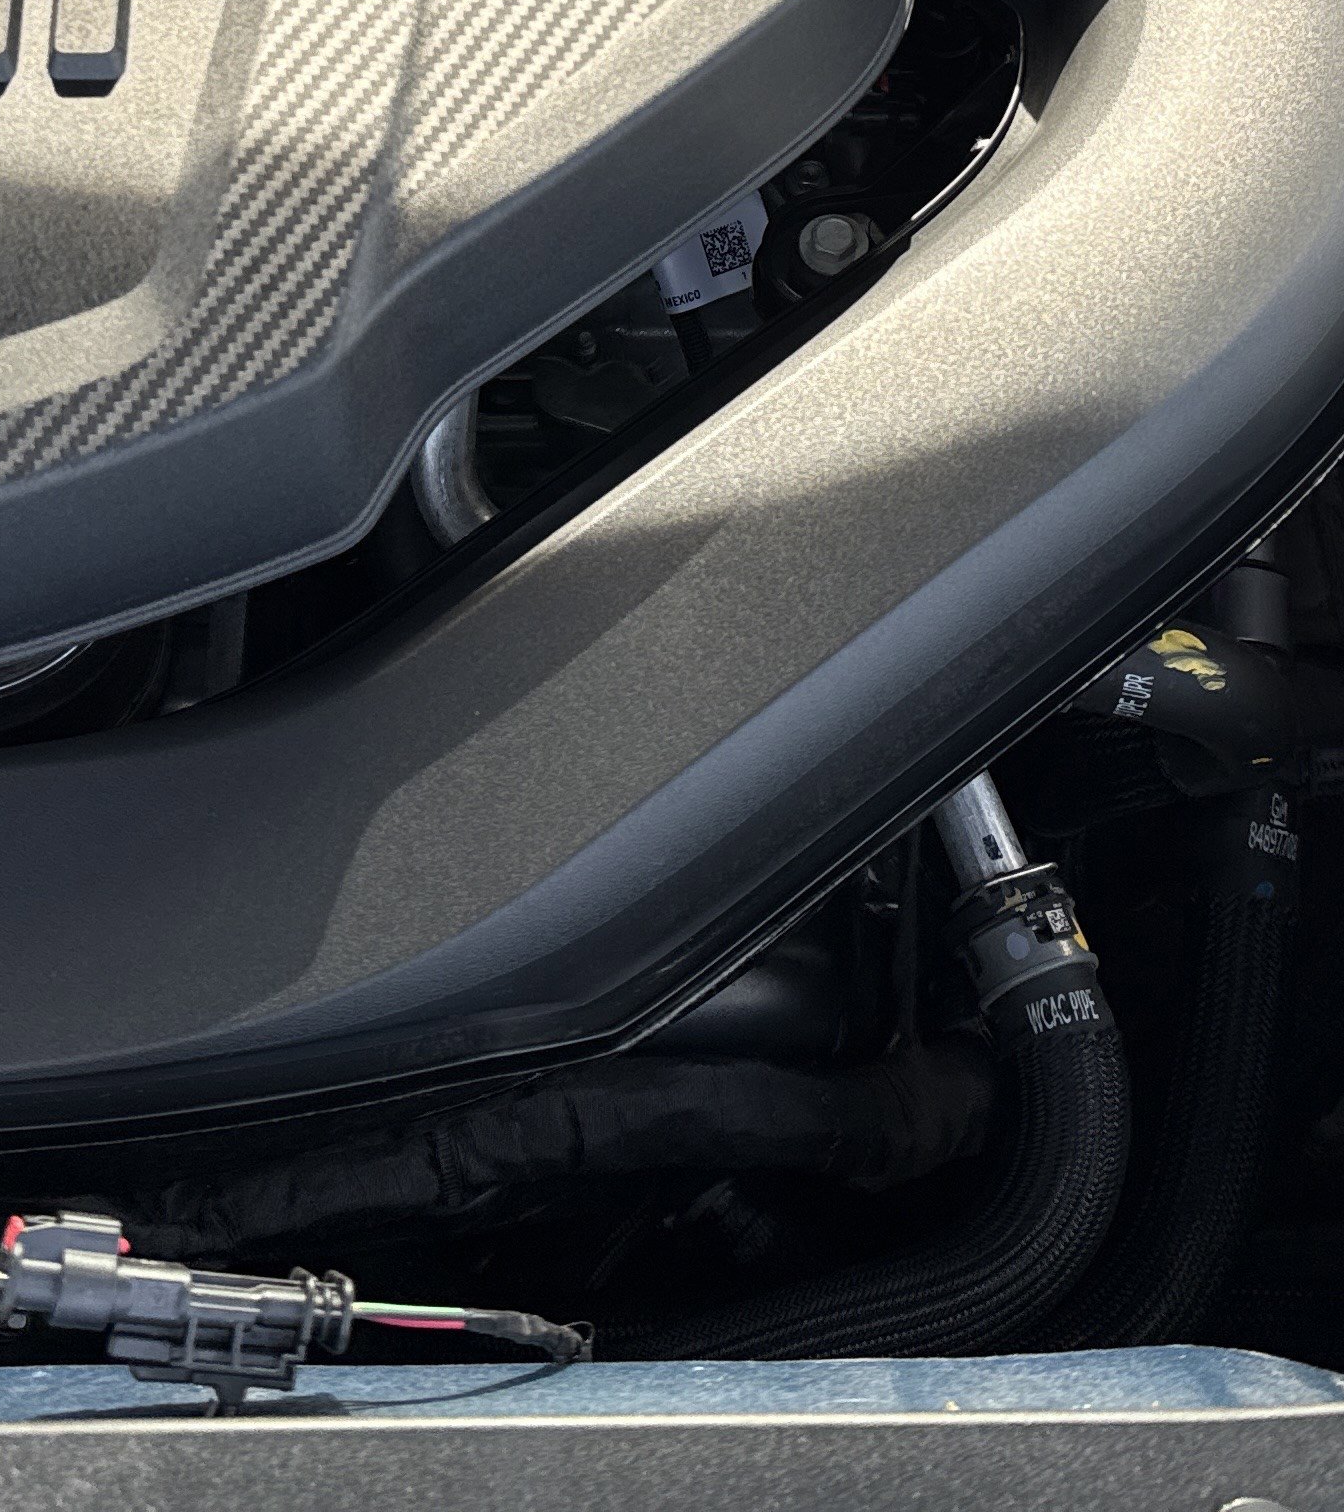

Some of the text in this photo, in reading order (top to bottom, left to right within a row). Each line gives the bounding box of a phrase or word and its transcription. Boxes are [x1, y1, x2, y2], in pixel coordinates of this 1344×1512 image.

[665, 289, 701, 308] MEXICO
[1122, 673, 1154, 699] UPR
[1026, 989, 1099, 1035] WCAC PIPE
